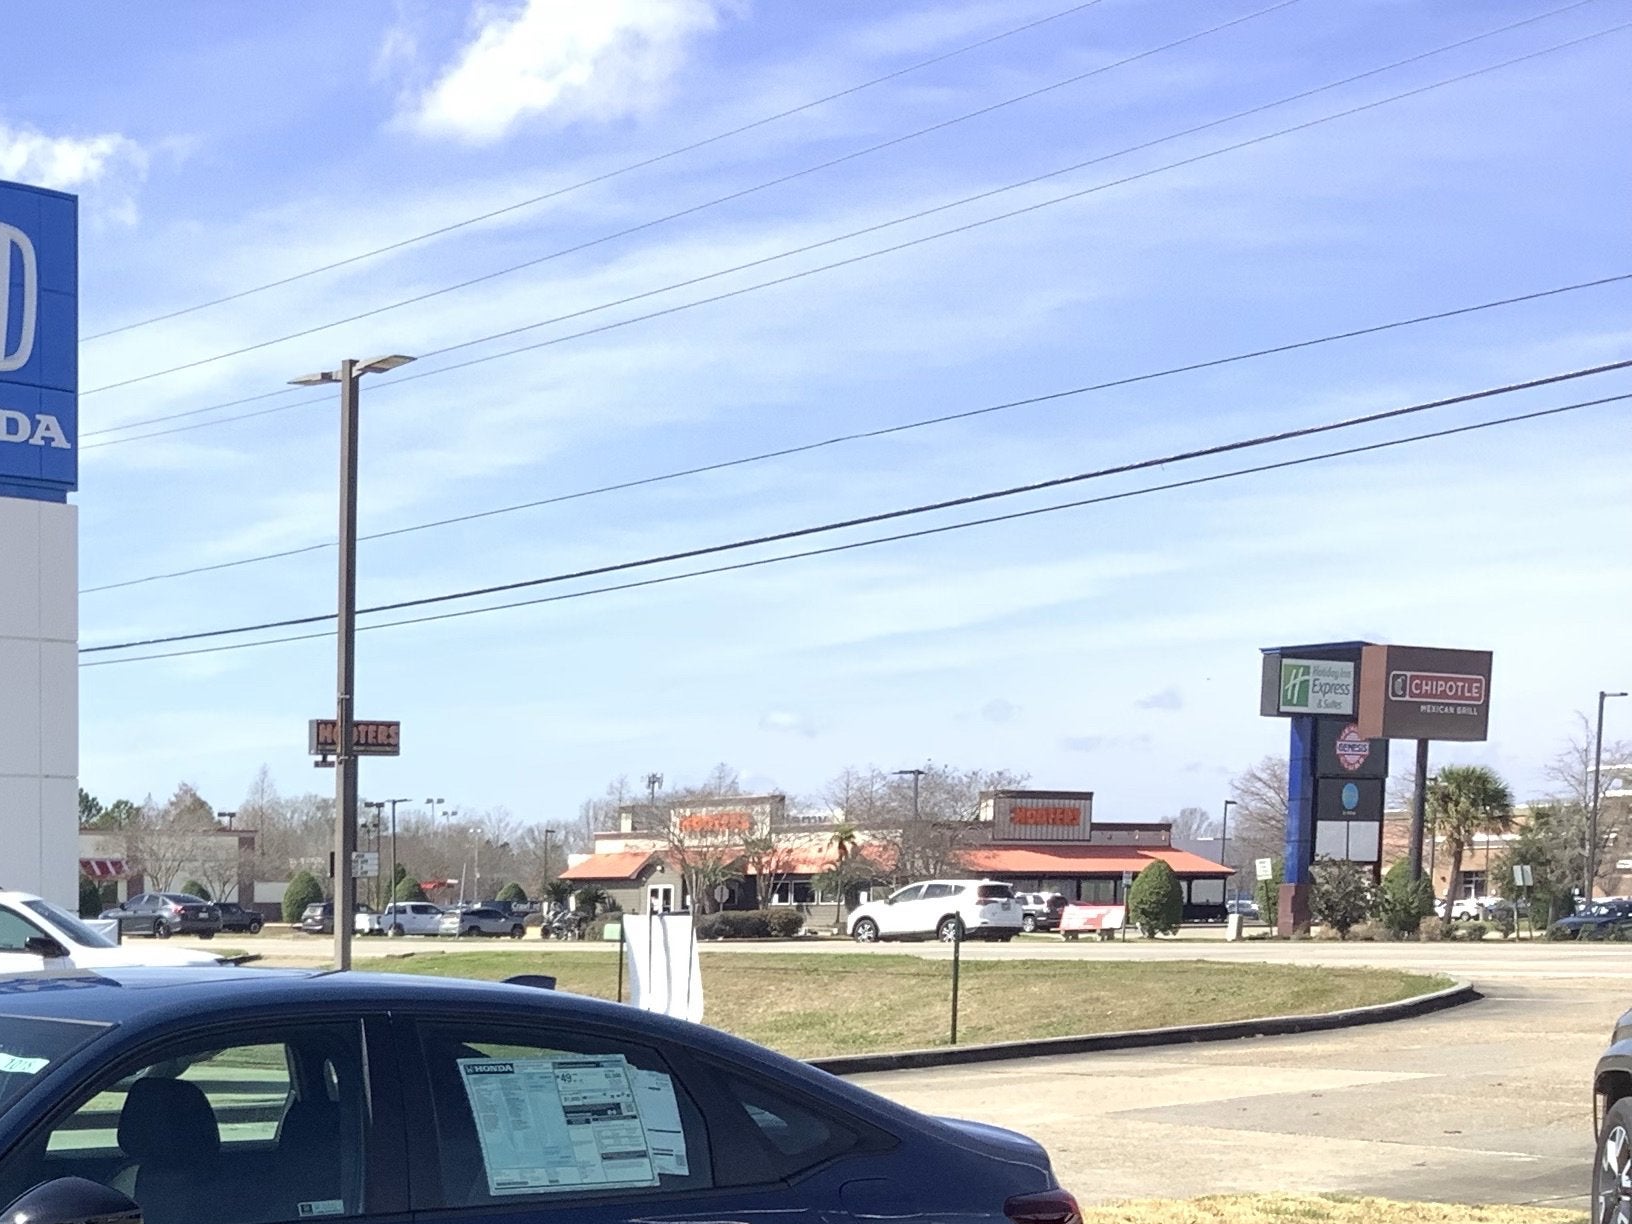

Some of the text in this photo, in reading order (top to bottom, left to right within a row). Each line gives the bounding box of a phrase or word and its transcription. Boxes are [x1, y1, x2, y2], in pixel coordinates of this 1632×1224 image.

[1312, 678, 1350, 698] Express
[1411, 679, 1480, 698] CHIPOTLE
[1420, 704, 1478, 715] MEXICAN GRILL
[1338, 742, 1368, 752] GENESIS
[474, 1064, 513, 1073] HONDA
